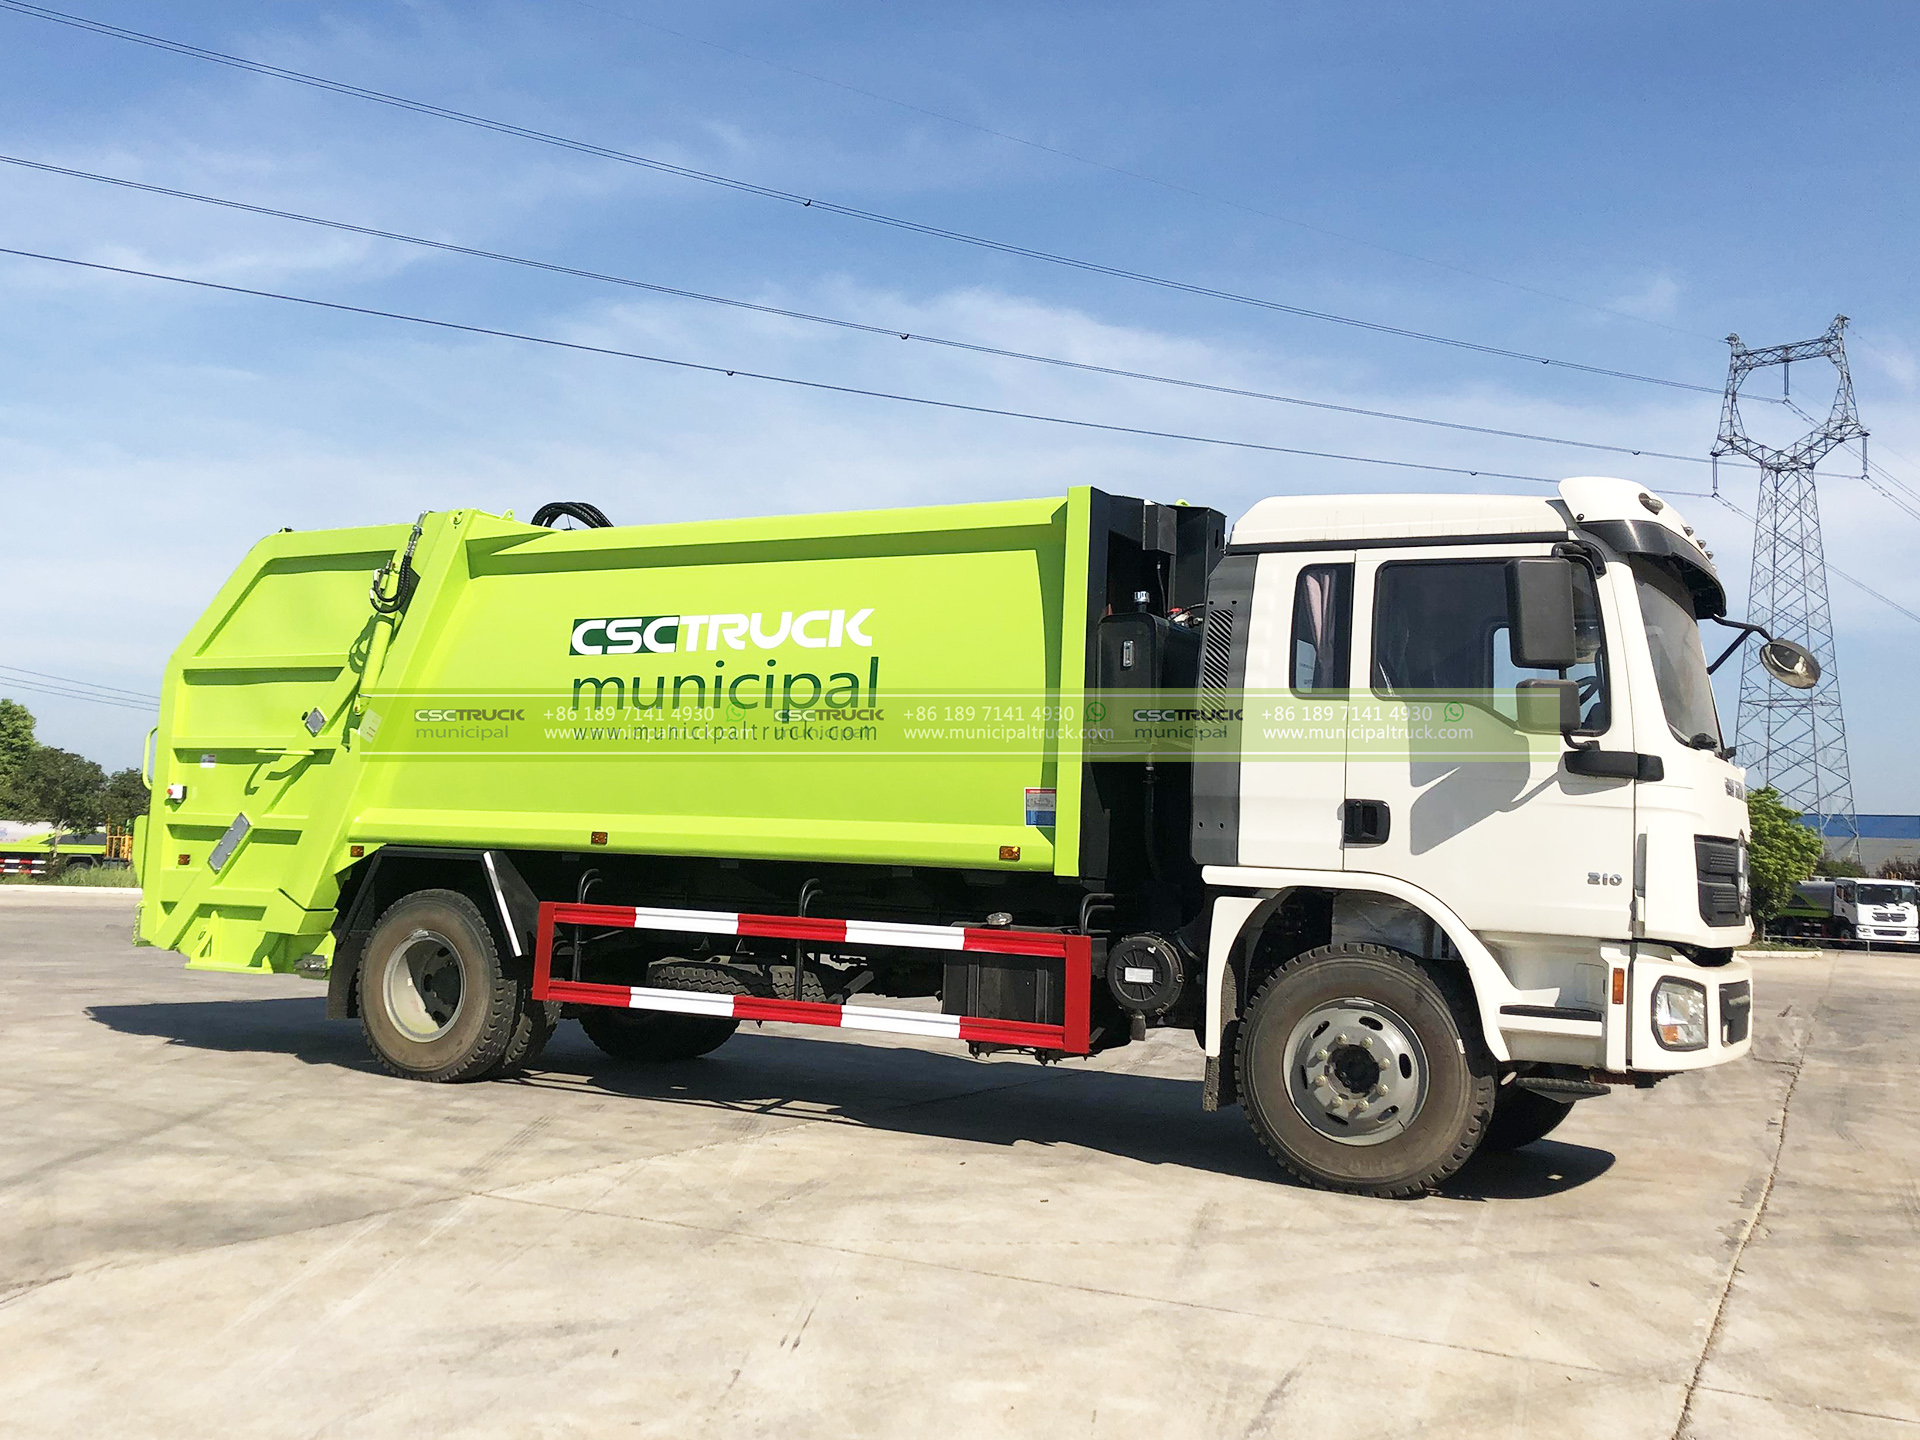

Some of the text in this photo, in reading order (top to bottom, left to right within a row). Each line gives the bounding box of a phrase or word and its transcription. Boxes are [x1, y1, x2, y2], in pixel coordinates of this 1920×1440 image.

[570, 608, 875, 655] CSCTRUCK
[572, 656, 879, 724] municipal
[573, 721, 877, 744] www.municipaltruck.com
[1587, 872, 1622, 886] 210
